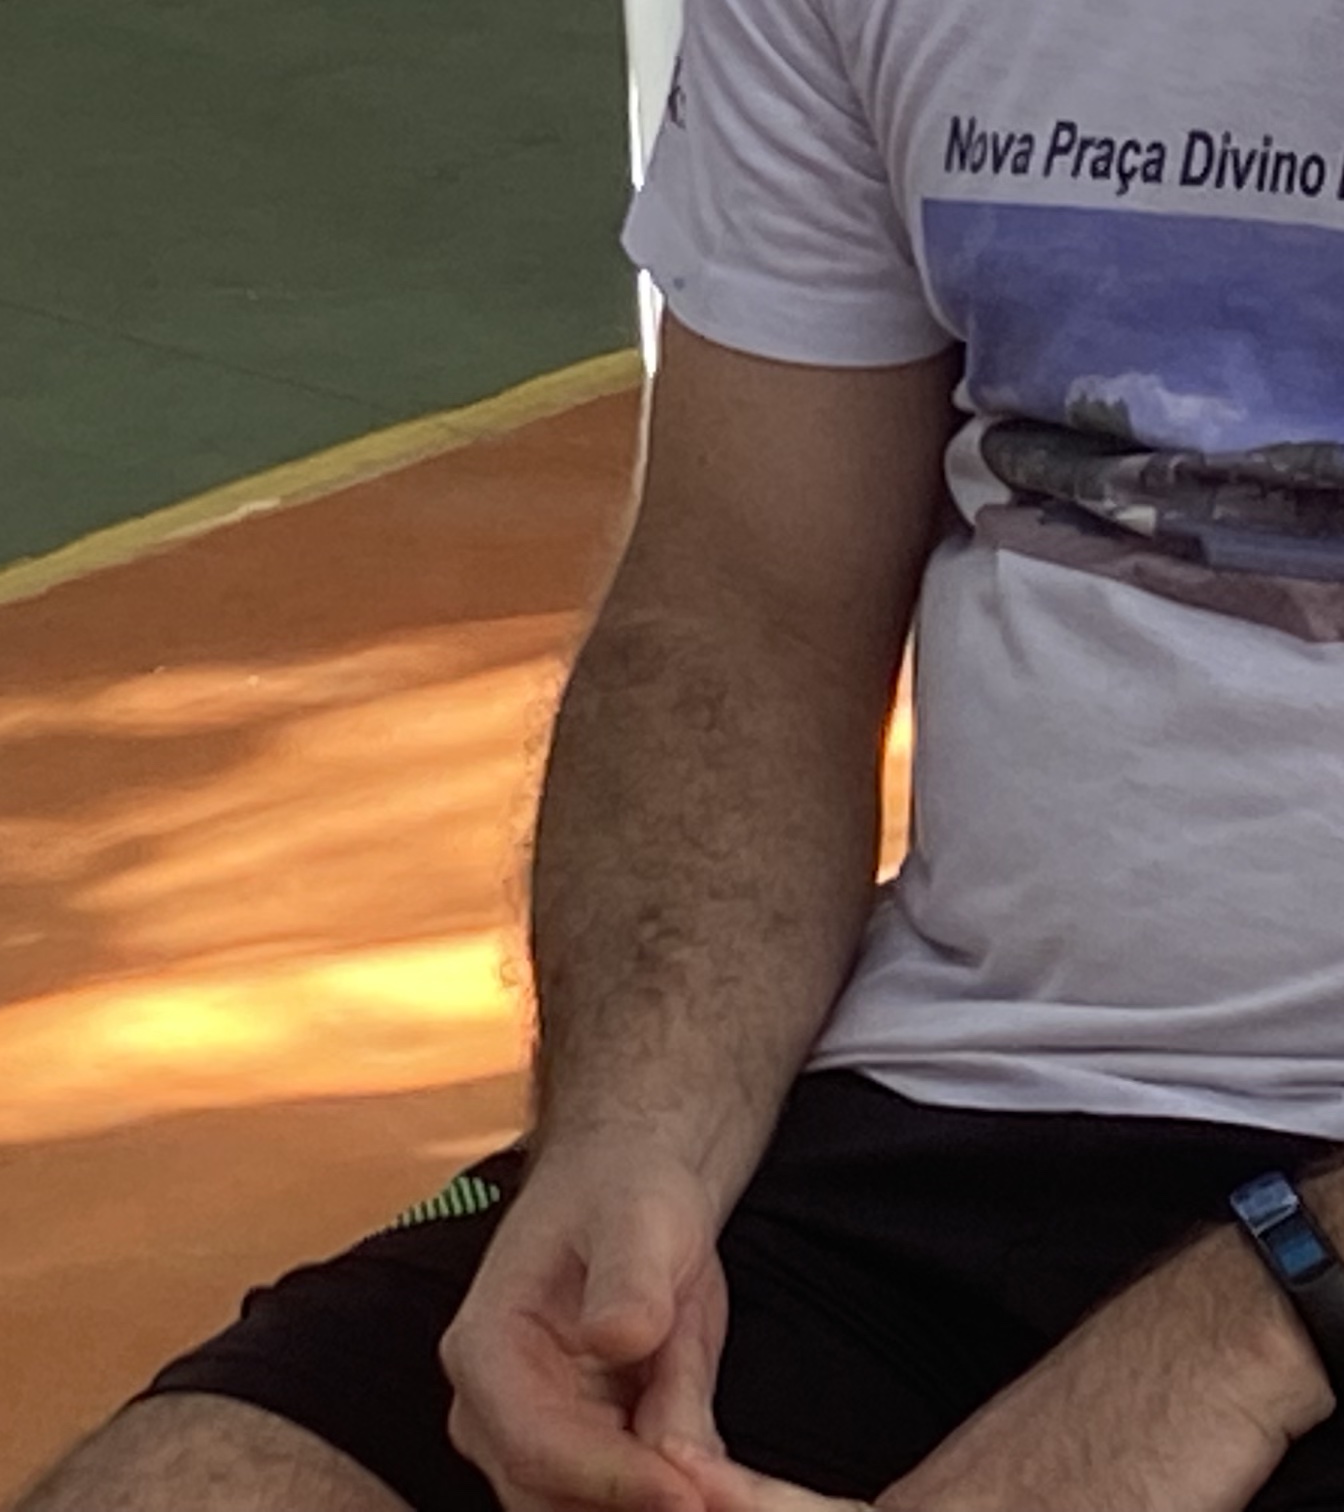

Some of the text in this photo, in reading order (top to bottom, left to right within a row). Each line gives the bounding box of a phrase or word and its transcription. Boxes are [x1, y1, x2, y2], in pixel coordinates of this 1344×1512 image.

[944, 116, 1035, 175] Nova
[1044, 120, 1167, 196] Praça
[1179, 129, 1326, 197] Divino
